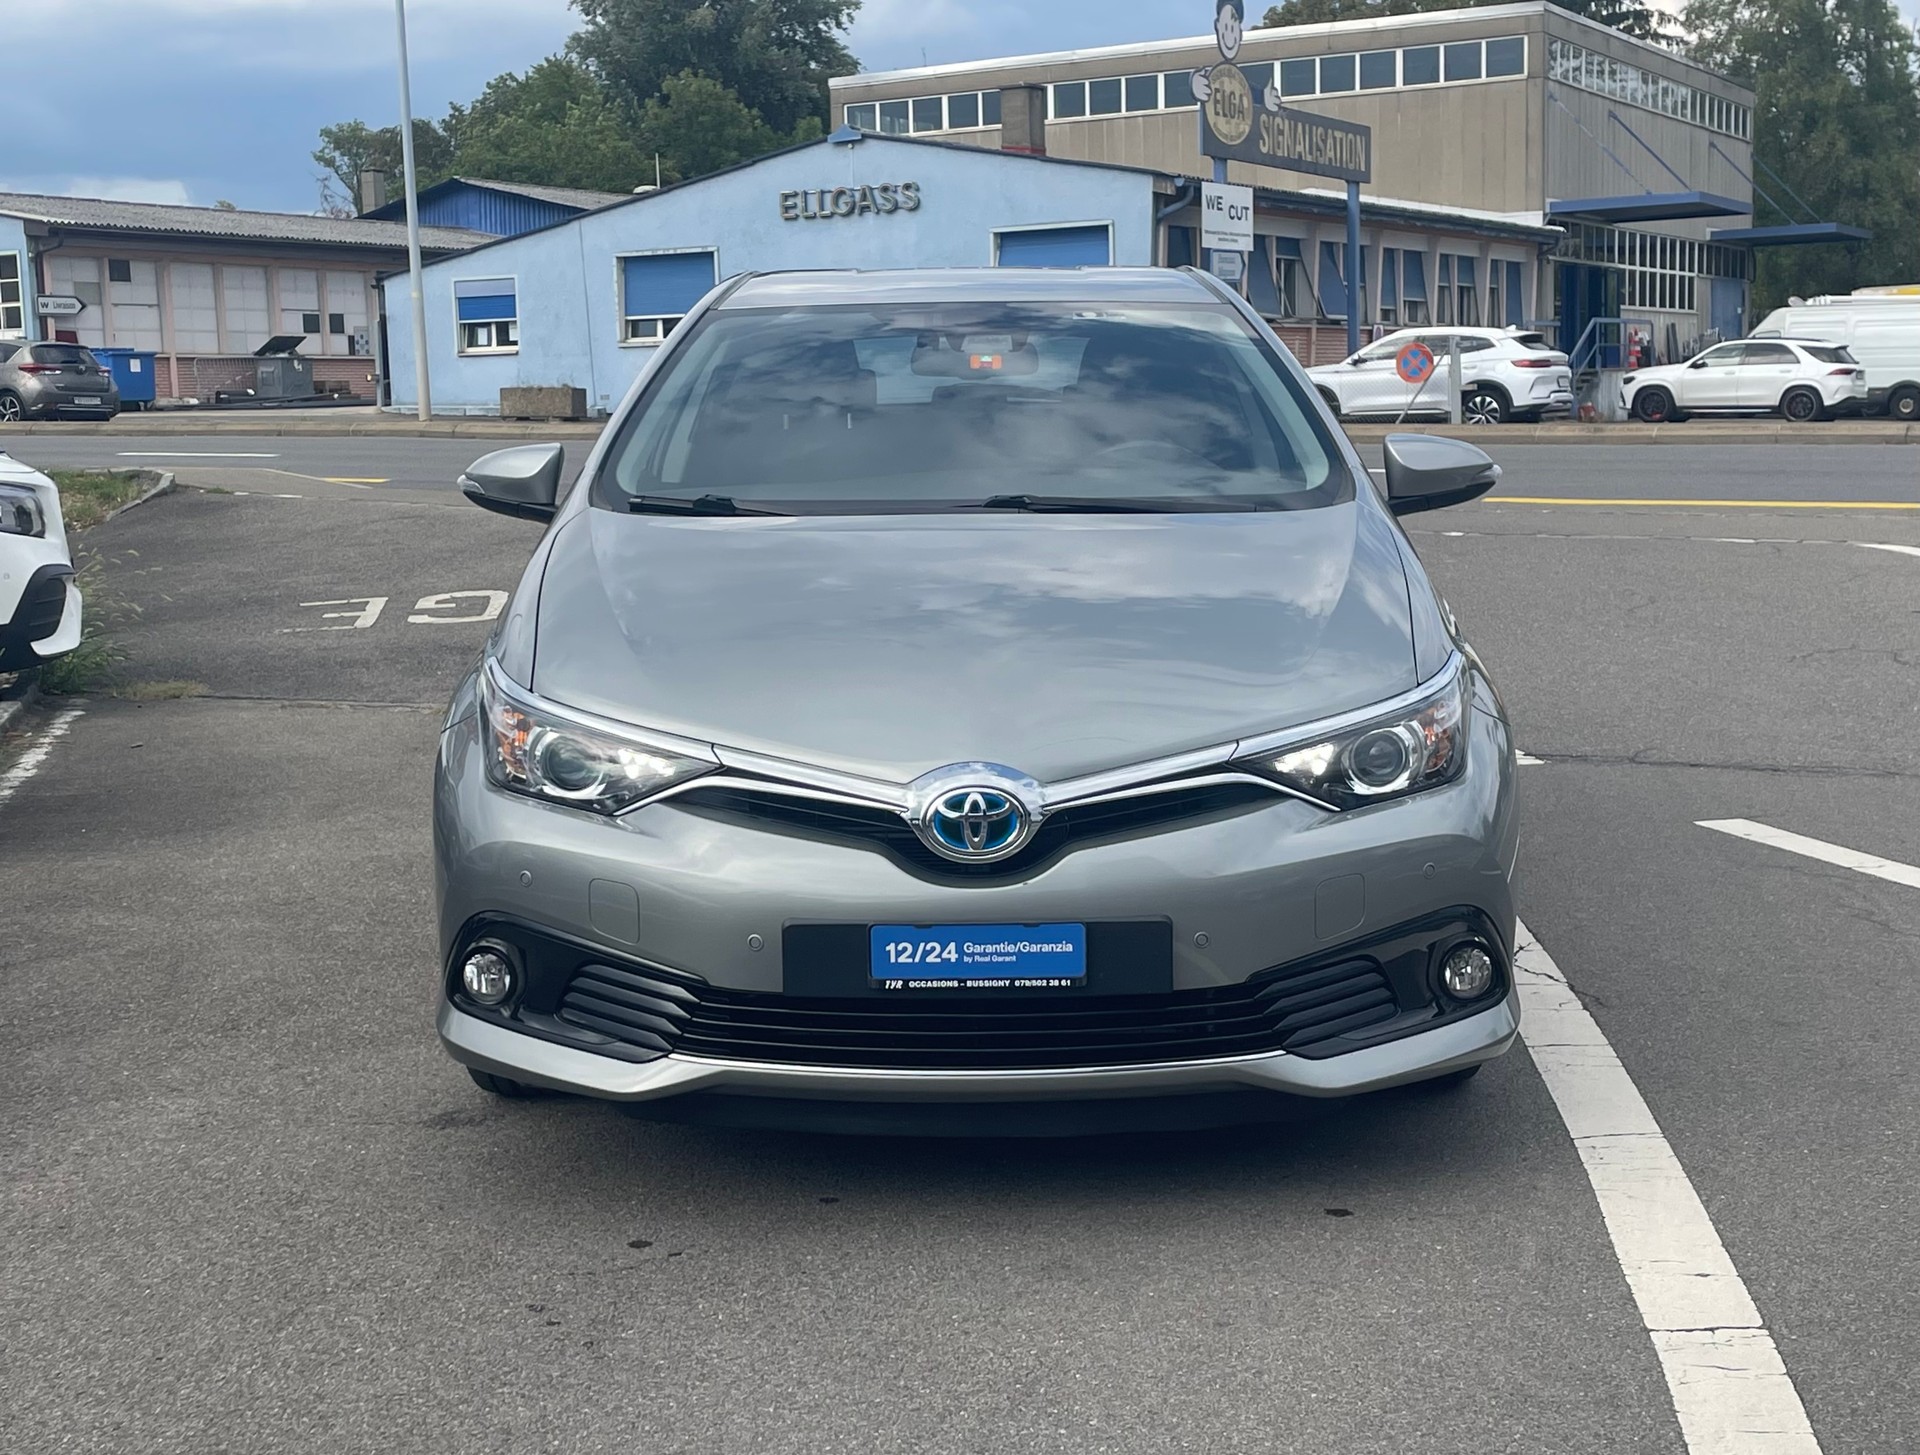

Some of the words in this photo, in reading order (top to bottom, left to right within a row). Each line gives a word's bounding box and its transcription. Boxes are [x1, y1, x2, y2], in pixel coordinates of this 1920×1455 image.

[1213, 87, 1246, 122] ELGA
[1259, 113, 1366, 172] SIGNALISATION
[779, 181, 920, 221] ELLGASS
[1205, 194, 1224, 212] WE
[1228, 204, 1250, 221] CUT
[885, 941, 959, 963] 12/24
[963, 940, 1073, 953] Garantie/Garanzia
[963, 955, 973, 964] by
[974, 954, 991, 963] Real
[991, 954, 1017, 963] Garant
[908, 980, 959, 988] OCCASIONS
[966, 979, 1011, 987] BUSSIGNY
